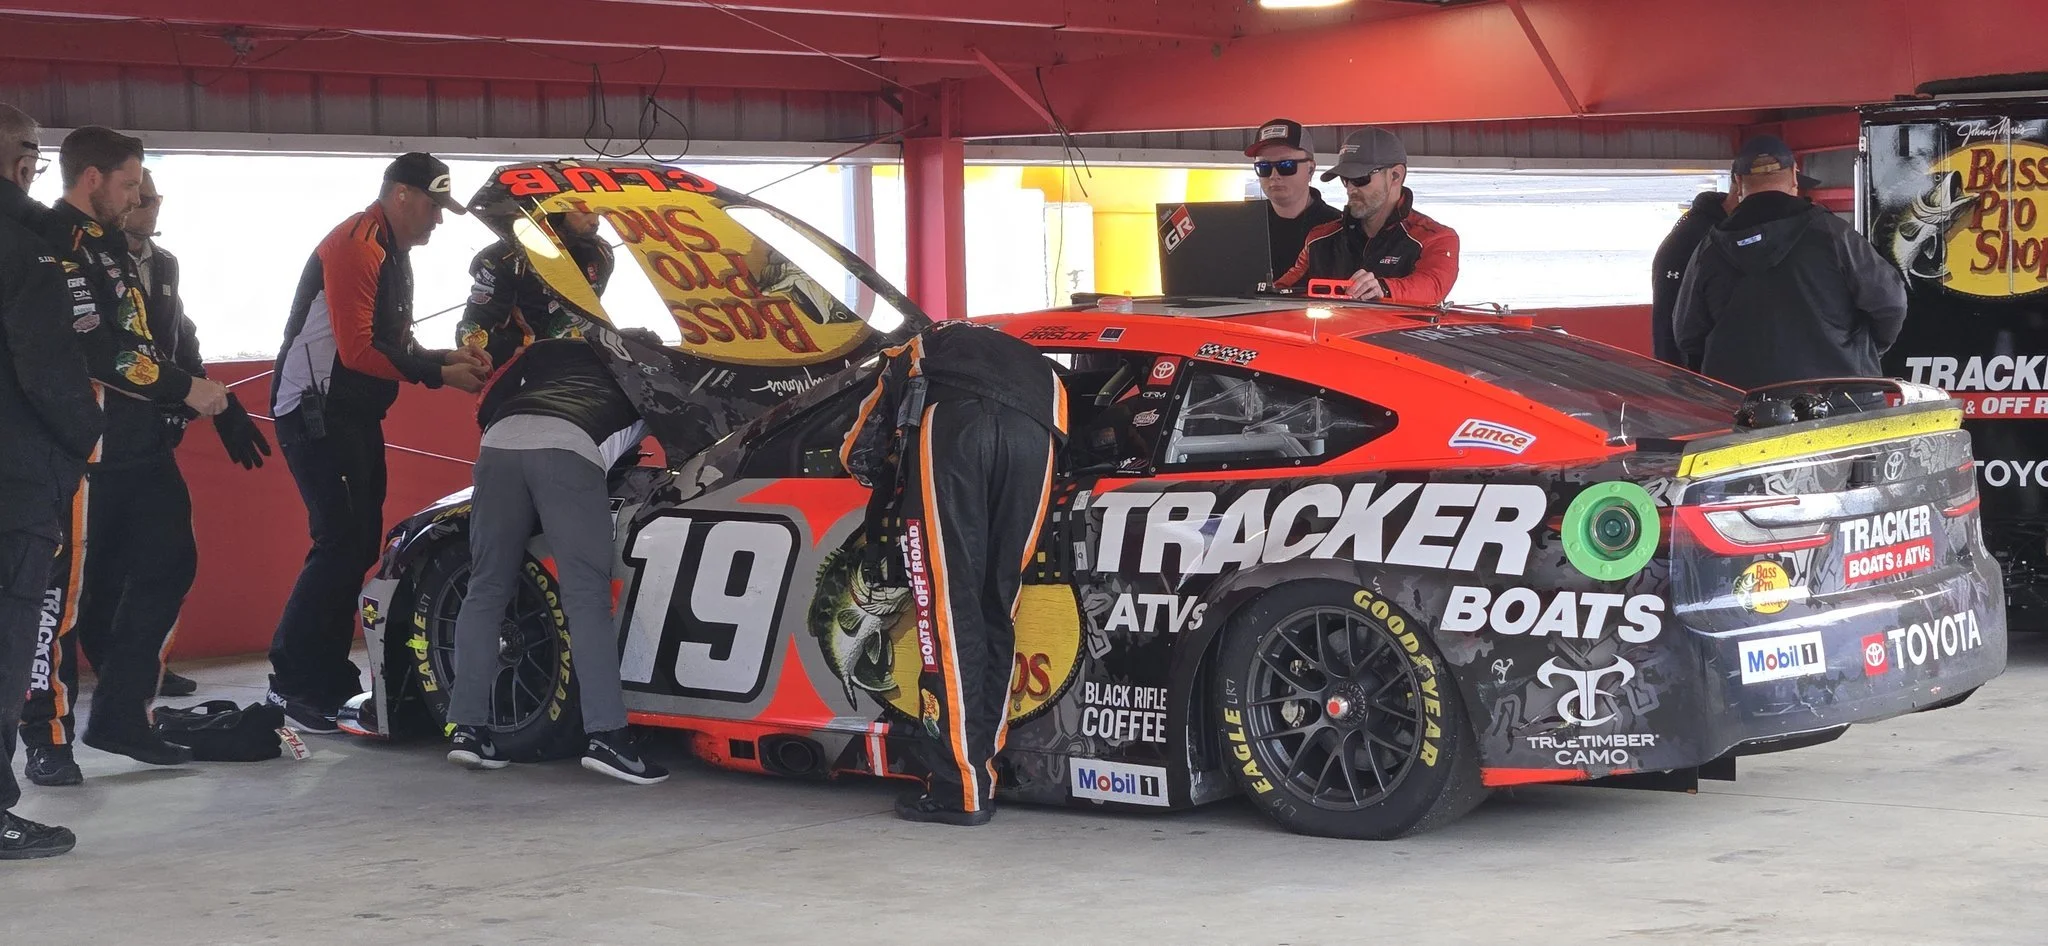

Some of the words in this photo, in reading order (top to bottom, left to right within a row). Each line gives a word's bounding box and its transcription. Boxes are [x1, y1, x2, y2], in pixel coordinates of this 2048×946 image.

[500, 167, 718, 196] CLUB
[1969, 190, 2037, 230] Pro
[1164, 217, 1193, 250] GR
[655, 251, 765, 300] Pro
[1257, 282, 1266, 292] 19
[678, 299, 822, 354] Bass
[1020, 331, 1097, 341] BRISCOE
[1905, 355, 2048, 391] TRACK
[1965, 400, 1976, 415] &
[1981, 397, 2031, 414] OFF
[1458, 421, 1528, 448] Lance
[1090, 482, 1547, 575] TRACKER
[1839, 504, 1932, 554] TRACKER
[1756, 565, 1777, 580] Bass
[1849, 552, 1894, 579] BOATS
[1895, 553, 1903, 568] &
[1904, 545, 1931, 567] ATVs
[912, 573, 930, 606] OFF
[1757, 579, 1774, 592] Pro
[619, 516, 793, 695] 19
[921, 609, 929, 618] &
[1104, 592, 1208, 632] ATVs
[1440, 585, 1665, 643] BOATS
[30, 587, 62, 692] TRACKER
[918, 619, 936, 666] BOATS
[1887, 609, 1982, 669] TOYOTA
[1748, 645, 1799, 673] Mobil
[1803, 643, 1817, 665] 1
[1353, 589, 1439, 768] GOODYEAR
[1085, 682, 1131, 708] BLACK
[1134, 684, 1167, 711] RIFLE
[1082, 709, 1167, 743] COFFEE
[1224, 707, 1274, 794] EAGLE
[1555, 750, 1629, 765] CAMO
[1078, 767, 1135, 796] Mobil
[1141, 775, 1159, 798] 1
